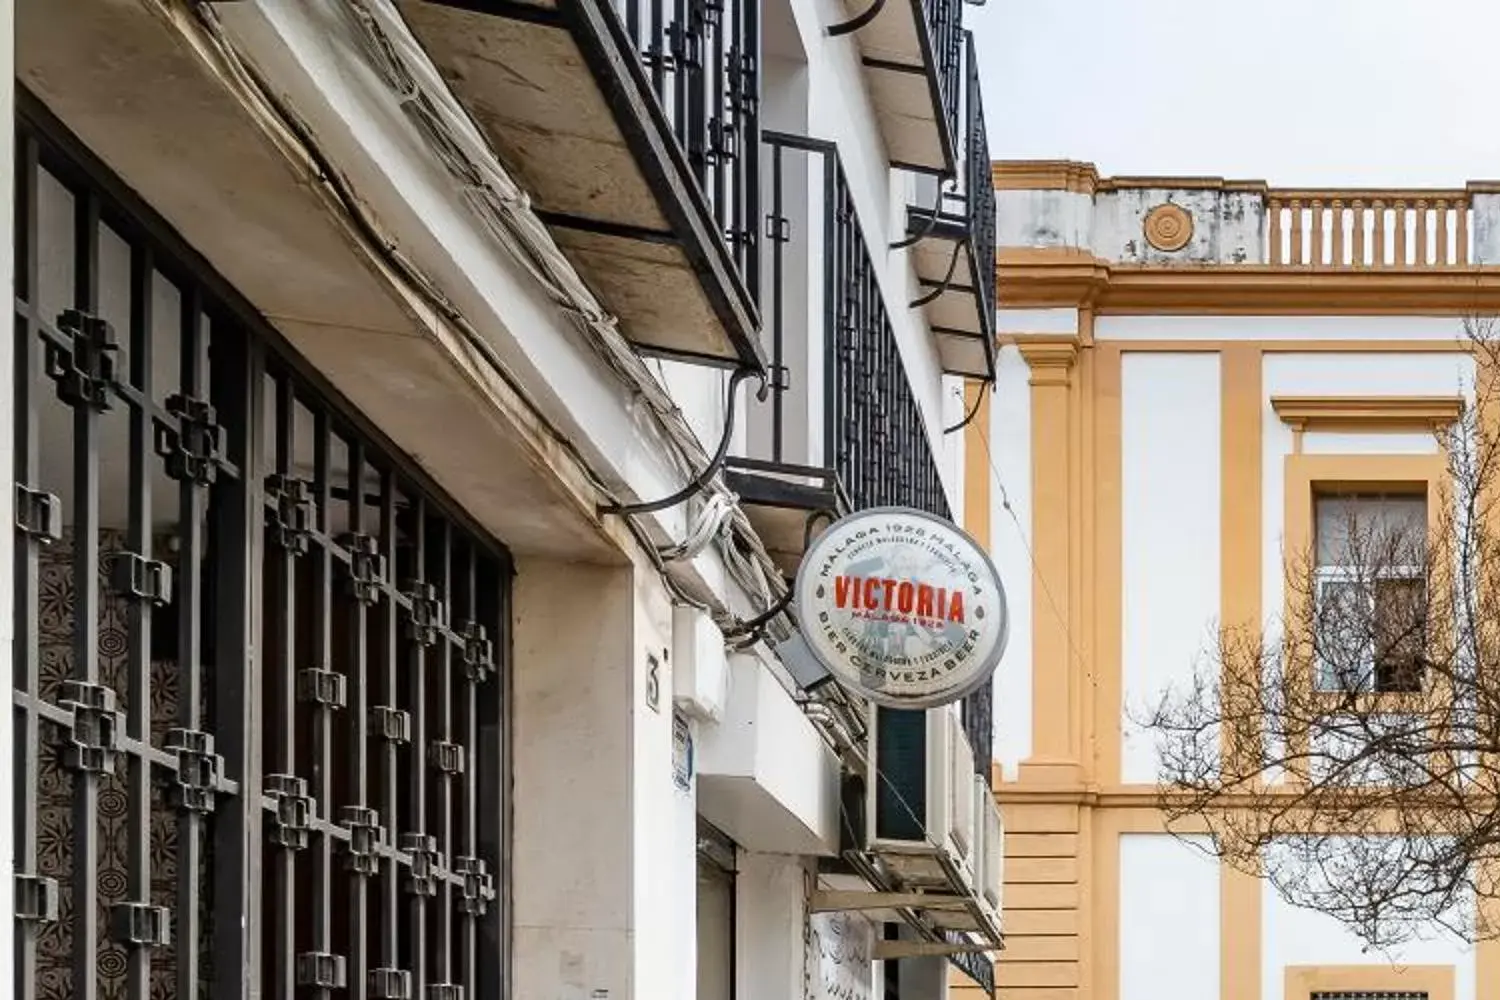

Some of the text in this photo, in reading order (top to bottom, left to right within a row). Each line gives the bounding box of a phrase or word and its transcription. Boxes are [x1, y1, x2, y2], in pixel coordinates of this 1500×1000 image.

[834, 575, 965, 624] VICTORIA
[849, 655, 942, 683] CERVEZA
[944, 629, 981, 671] BEER
